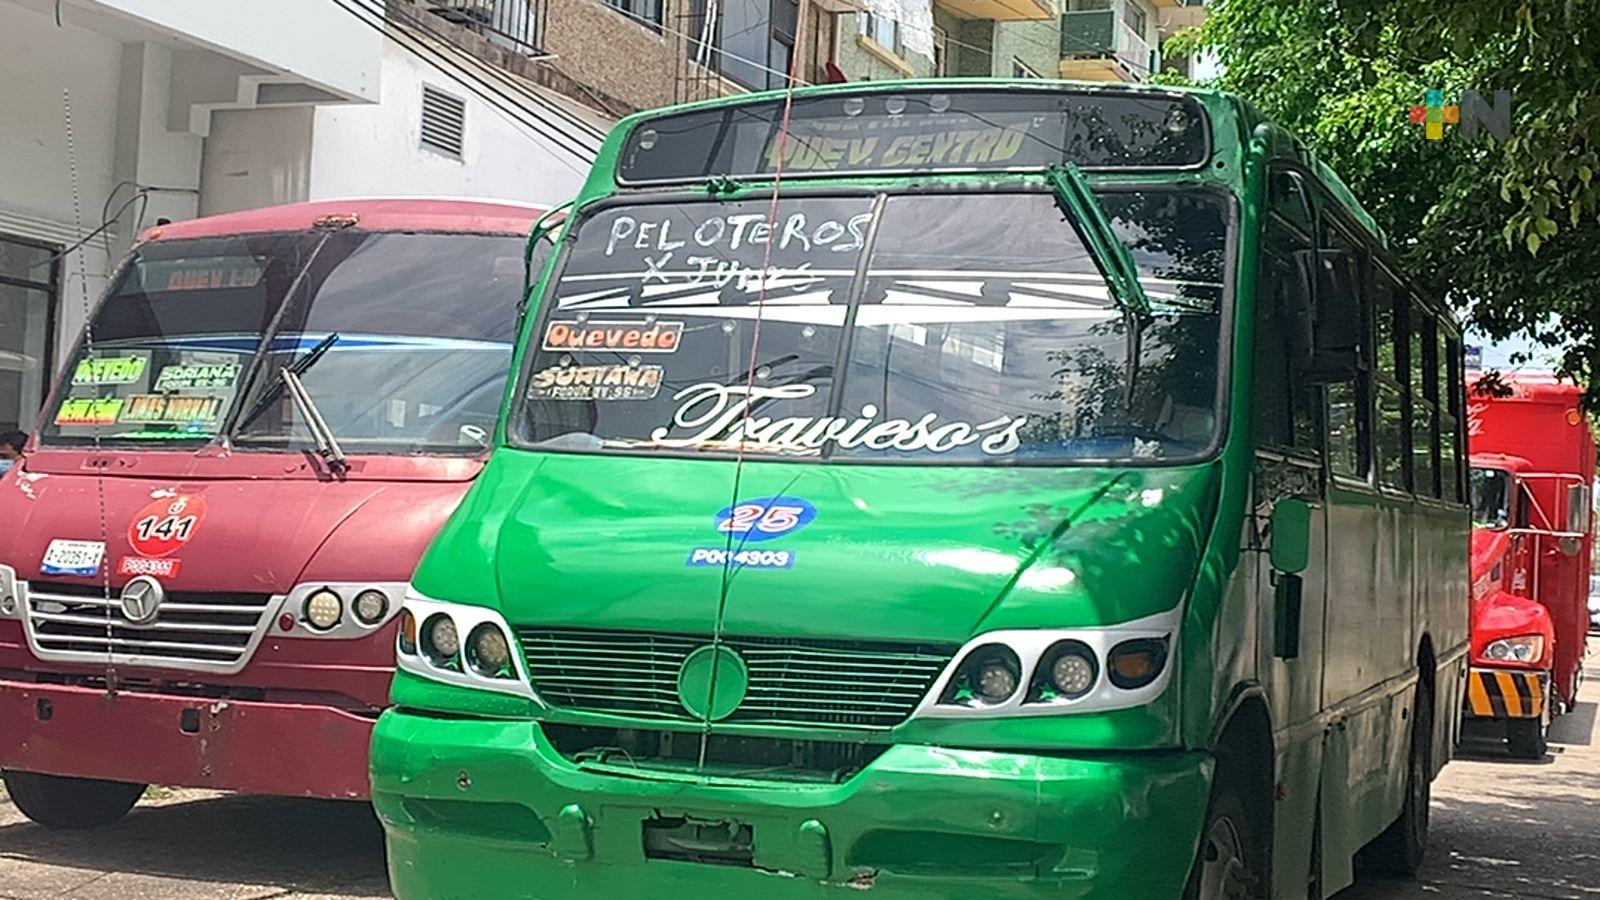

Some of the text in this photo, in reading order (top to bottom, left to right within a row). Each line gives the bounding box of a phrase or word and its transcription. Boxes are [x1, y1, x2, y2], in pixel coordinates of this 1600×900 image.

[881, 121, 1032, 167] CENTRO
[605, 213, 873, 256] PELOTEROS
[547, 324, 677, 349] Quevedo
[160, 364, 235, 381] SORIANA
[533, 366, 659, 388] SORIANA
[136, 515, 198, 542] 141
[716, 504, 804, 532] 25
